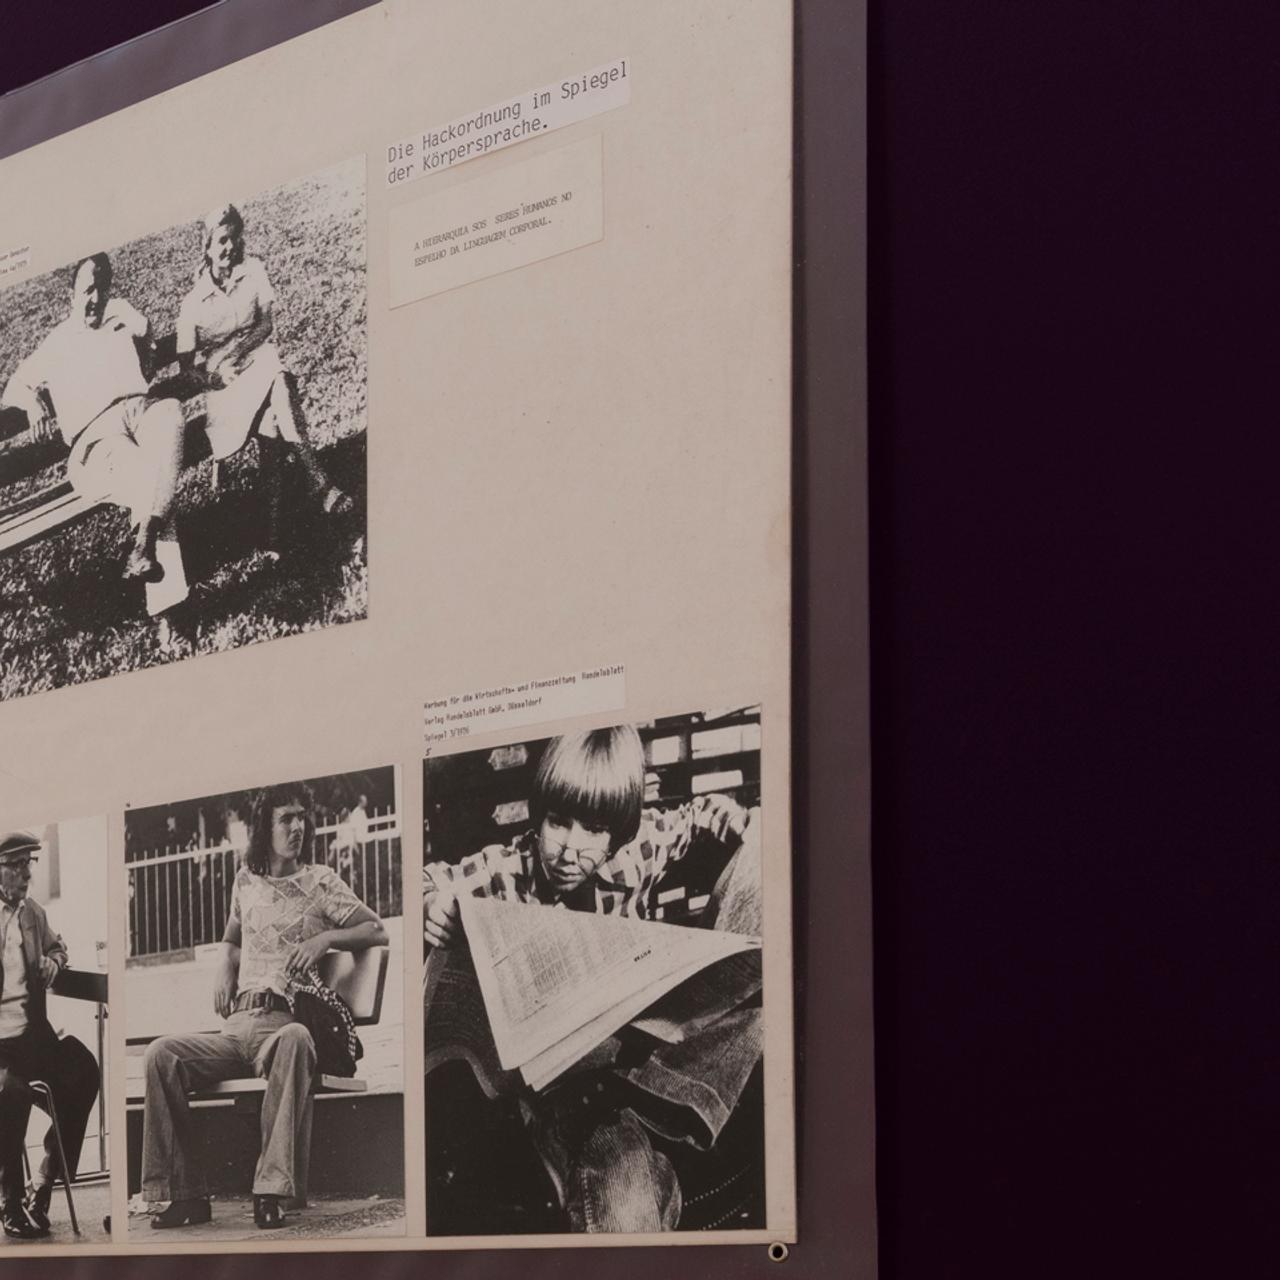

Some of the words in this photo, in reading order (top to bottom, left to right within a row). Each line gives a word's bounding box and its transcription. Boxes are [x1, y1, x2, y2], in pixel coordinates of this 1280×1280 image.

[387, 142, 414, 164] Die
[422, 101, 522, 151] Hackordnung
[533, 91, 551, 110] im
[560, 60, 628, 100] Spiegel
[387, 163, 415, 184] der
[422, 117, 549, 172] Körpersprache.
